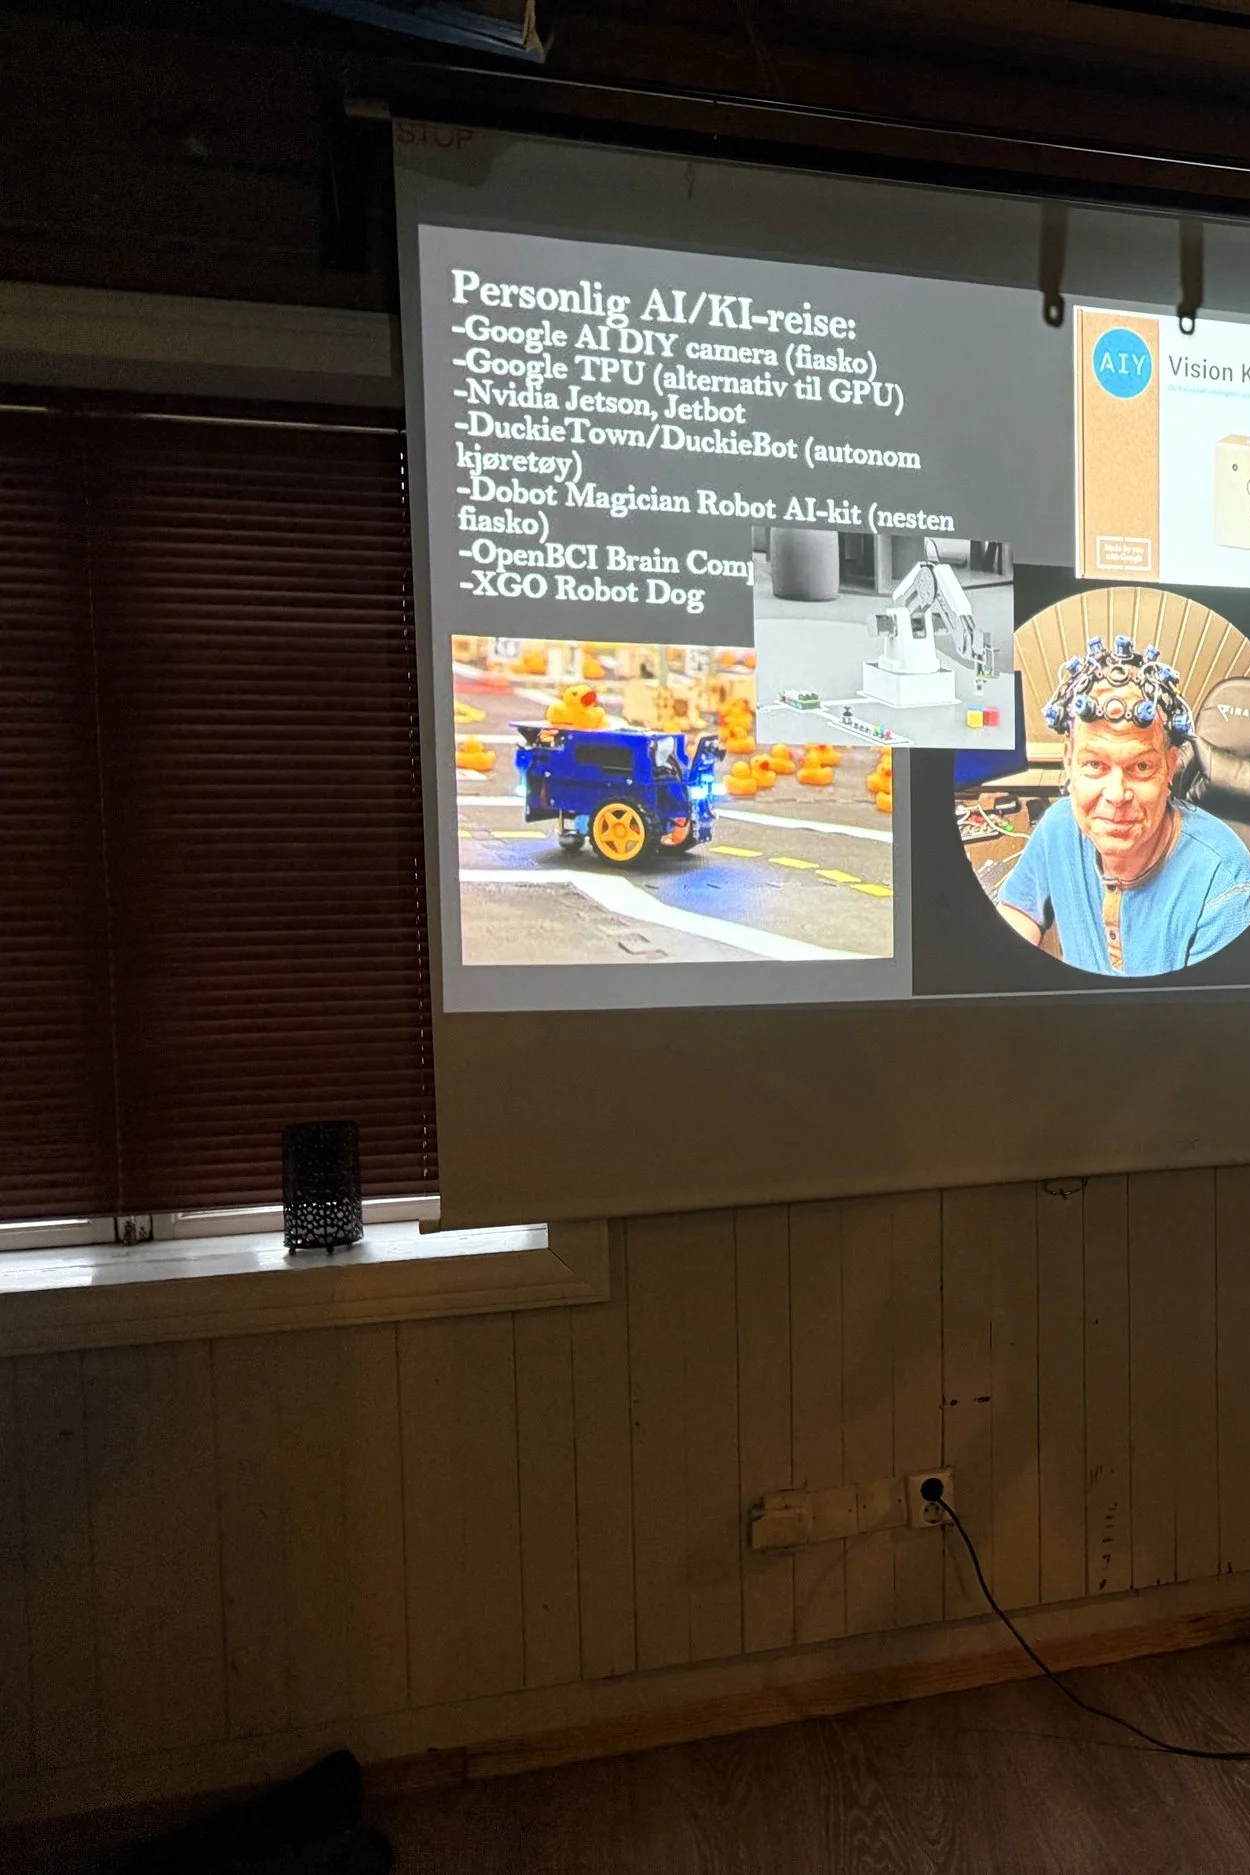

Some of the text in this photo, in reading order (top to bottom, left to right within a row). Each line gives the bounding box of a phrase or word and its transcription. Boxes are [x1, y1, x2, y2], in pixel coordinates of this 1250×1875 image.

[397, 122, 474, 148] STOP
[452, 269, 856, 340] Personlig AI/KI-reise:
[451, 314, 877, 382] -Google AI DIY camera (fiasko)
[1100, 351, 1146, 376] AIY
[1168, 355, 1233, 382] Vision
[452, 347, 904, 417] -Google TPU (alternativ til GPU)
[453, 377, 747, 424] -Nvidia Jetson, Jetbot
[456, 441, 582, 484] kjøretøy)
[805, 436, 921, 469] (autonom
[456, 474, 955, 534] -Dobot Magician Robot AI-kit (nesten
[457, 505, 550, 544] fiasko)
[458, 538, 598, 573] -OpenBCI
[606, 547, 679, 574] Brain
[459, 570, 705, 614] -XGO Robot Dog
